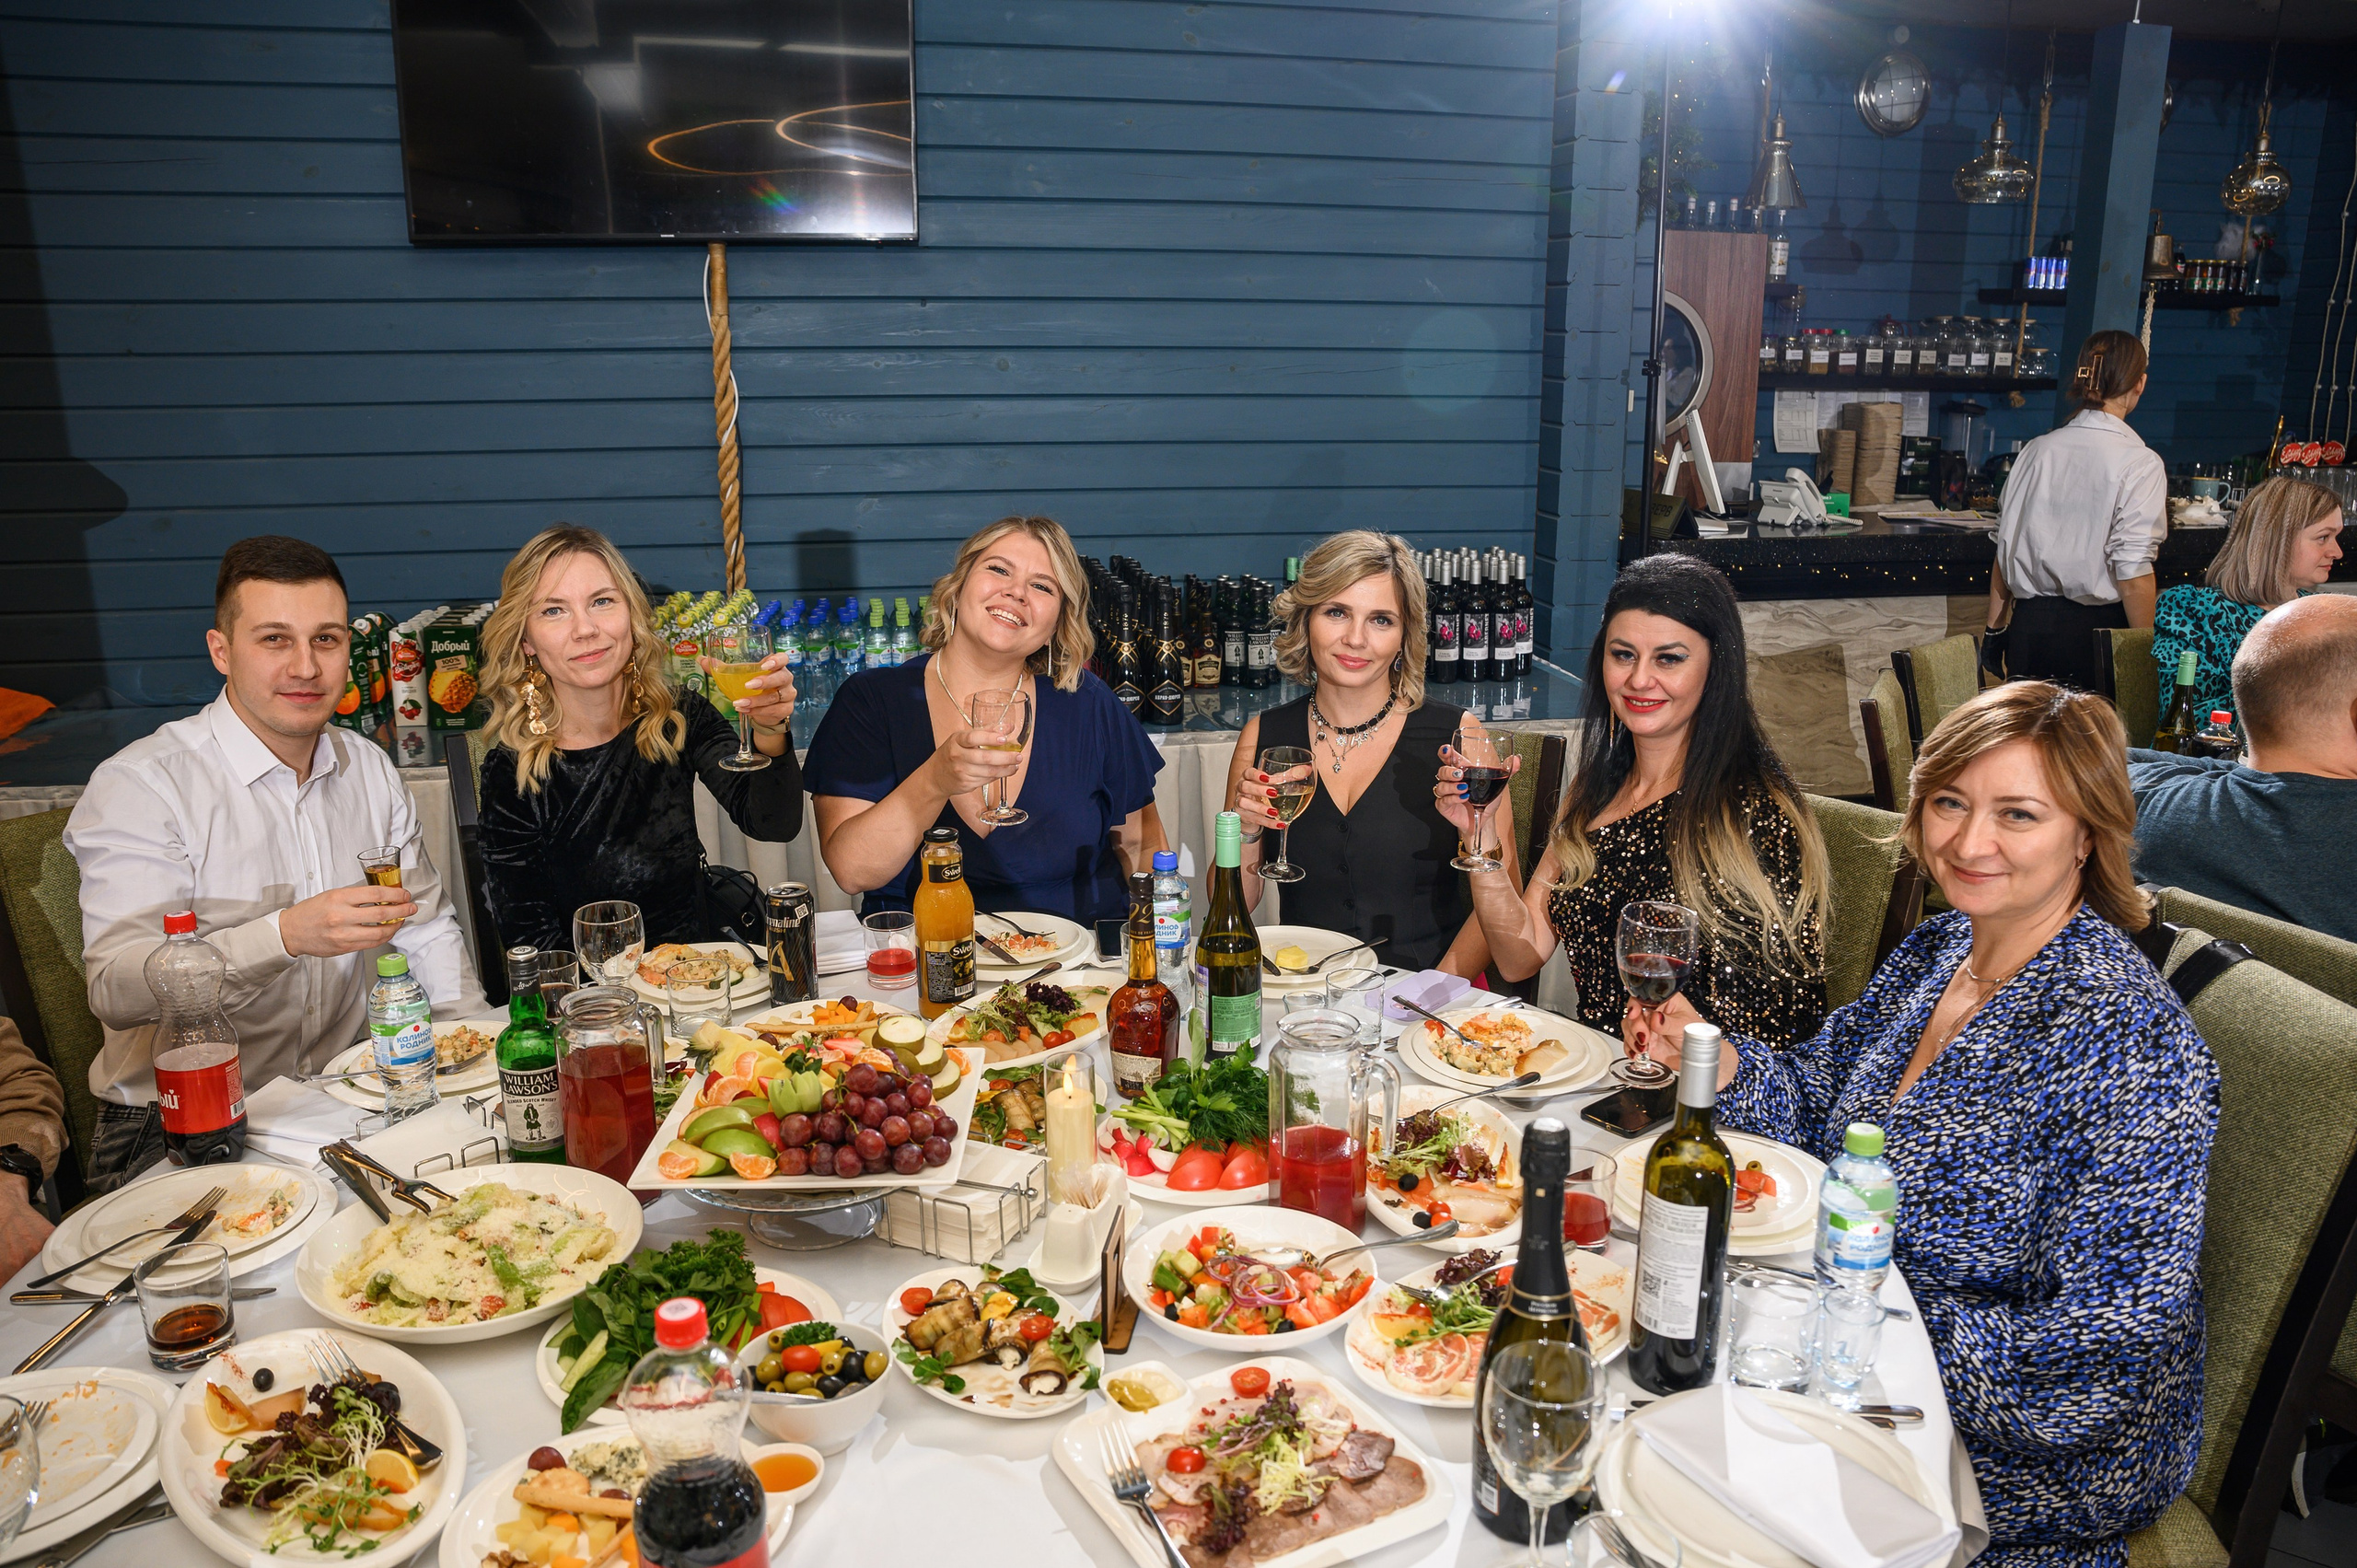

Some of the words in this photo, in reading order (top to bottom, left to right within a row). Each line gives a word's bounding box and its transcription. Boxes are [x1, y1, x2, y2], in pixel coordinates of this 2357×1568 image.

[1652, 503, 1673, 517] ЗЕРВ
[431, 640, 470, 653] Добрый
[767, 916, 801, 929] renaline
[400, 1035, 432, 1050] РОДНИК
[504, 1072, 554, 1086] WILLIAM
[503, 1080, 559, 1096] LAWSON'S
